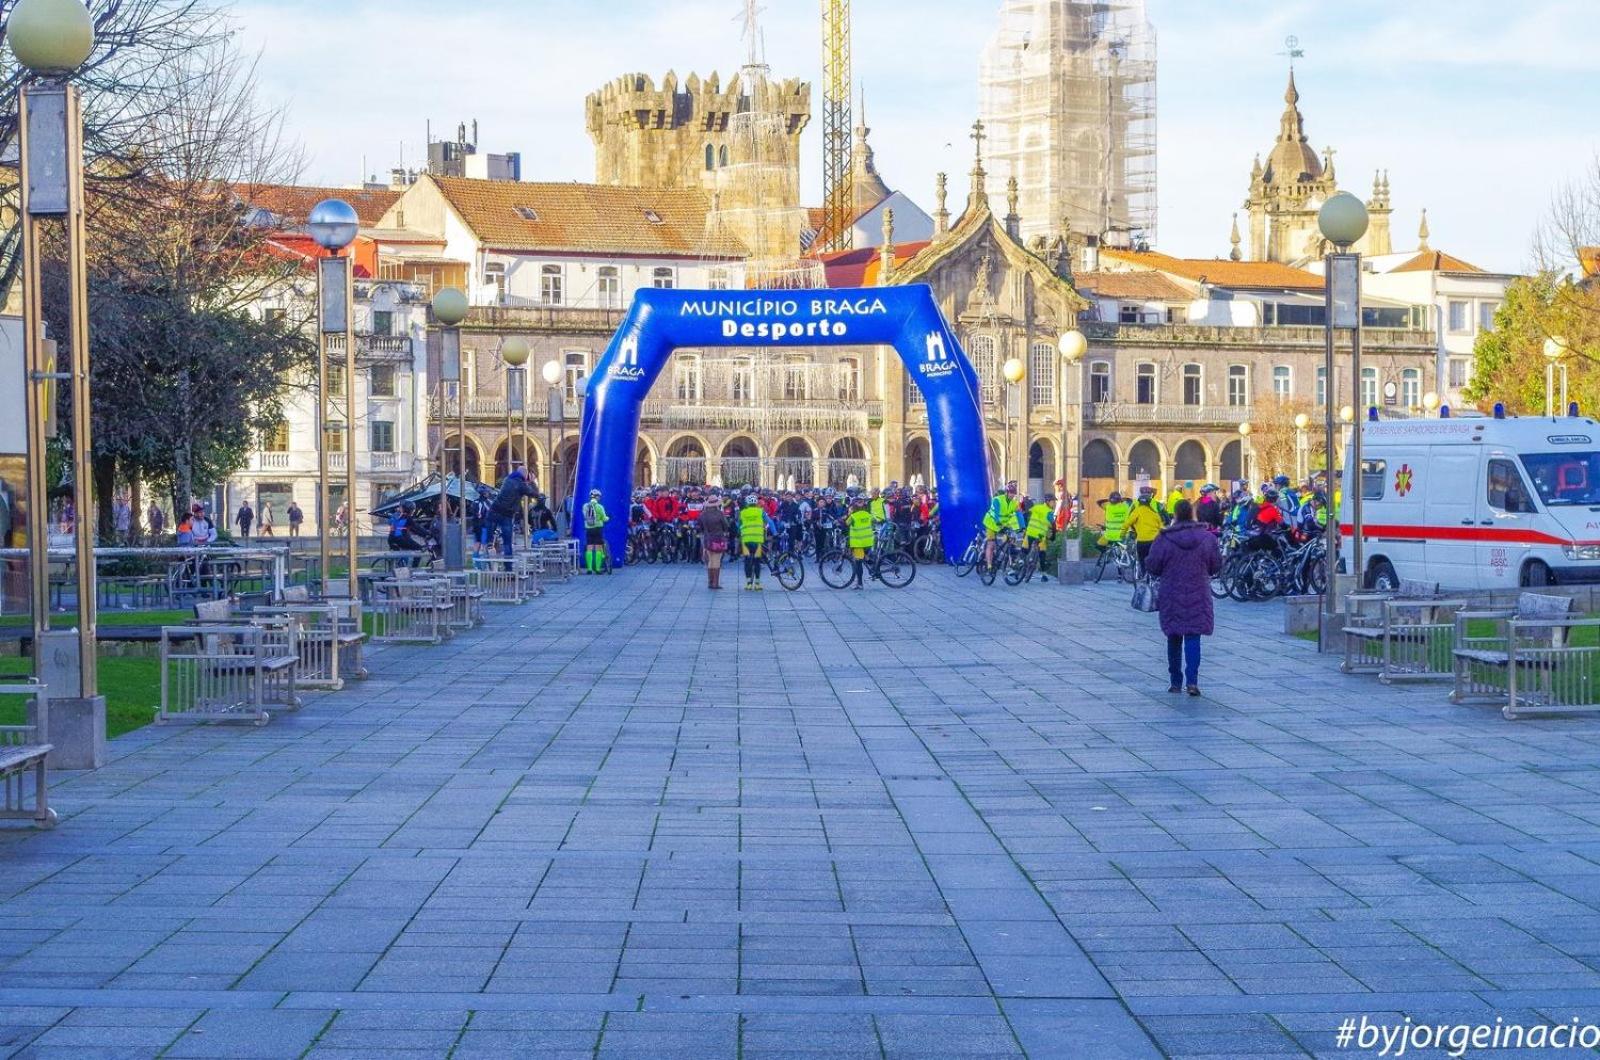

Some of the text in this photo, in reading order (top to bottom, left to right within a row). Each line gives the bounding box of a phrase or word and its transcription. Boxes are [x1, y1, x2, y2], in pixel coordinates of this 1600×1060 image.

[680, 298, 887, 316] MUNICÍPIO BRAGA
[722, 319, 847, 340] Desporto
[608, 366, 645, 376] BRAGA
[919, 360, 958, 373] BRAGA
